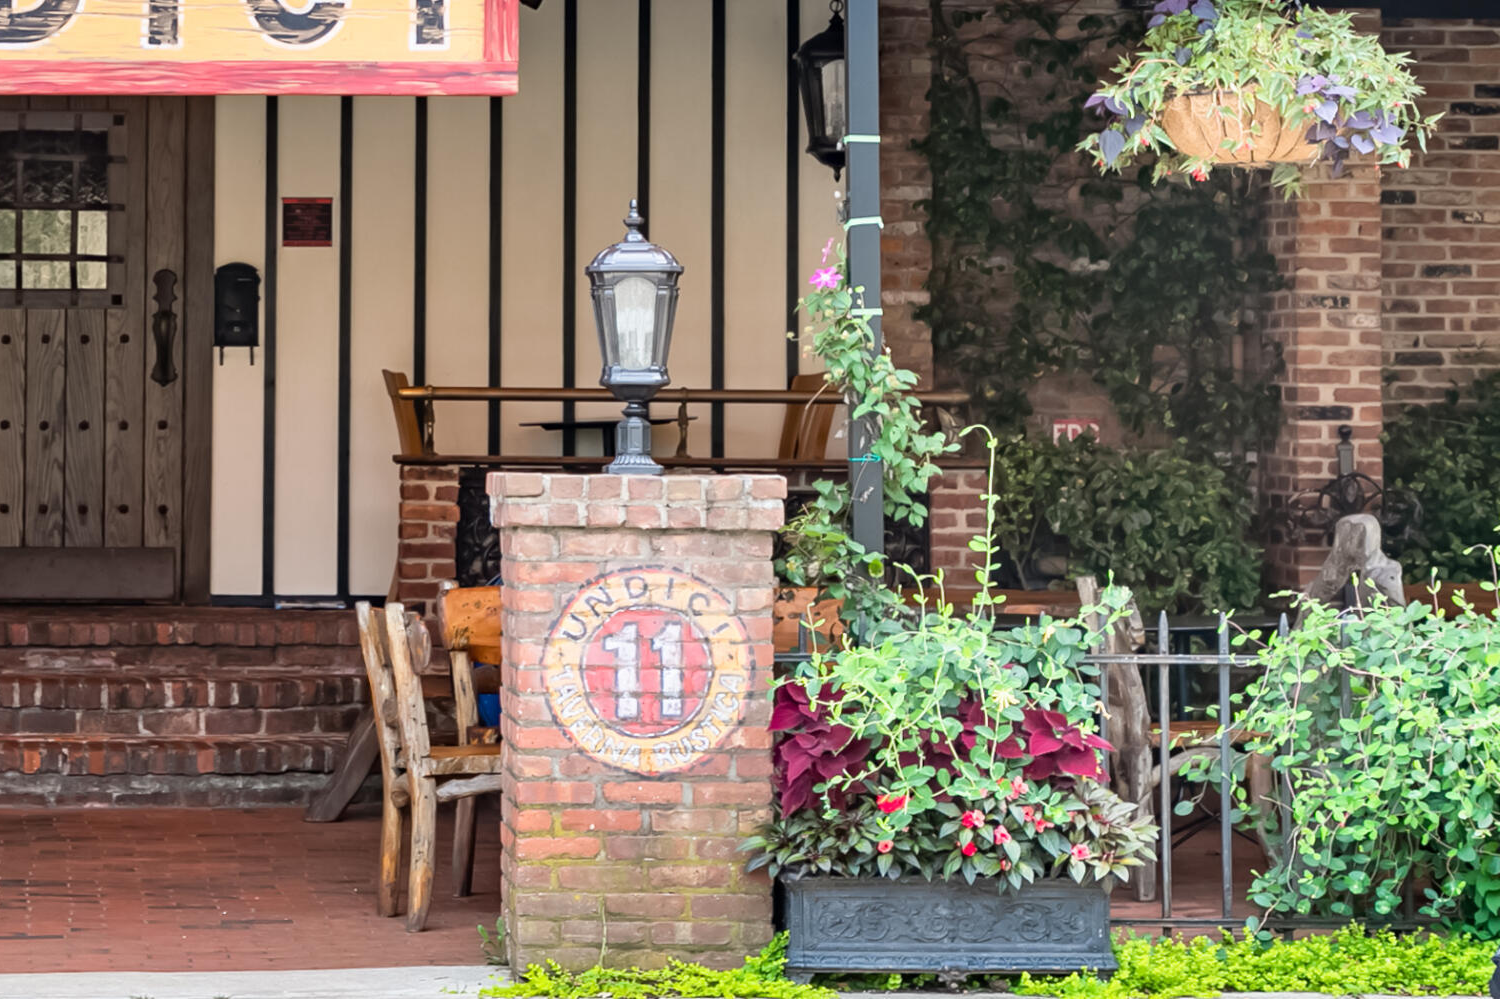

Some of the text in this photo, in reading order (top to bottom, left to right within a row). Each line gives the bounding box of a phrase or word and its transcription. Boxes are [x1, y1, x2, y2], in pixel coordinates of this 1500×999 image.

[561, 574, 731, 643] UNDICI
[550, 664, 746, 768] TAVERNA RUSTICA
[602, 620, 685, 721] 11
